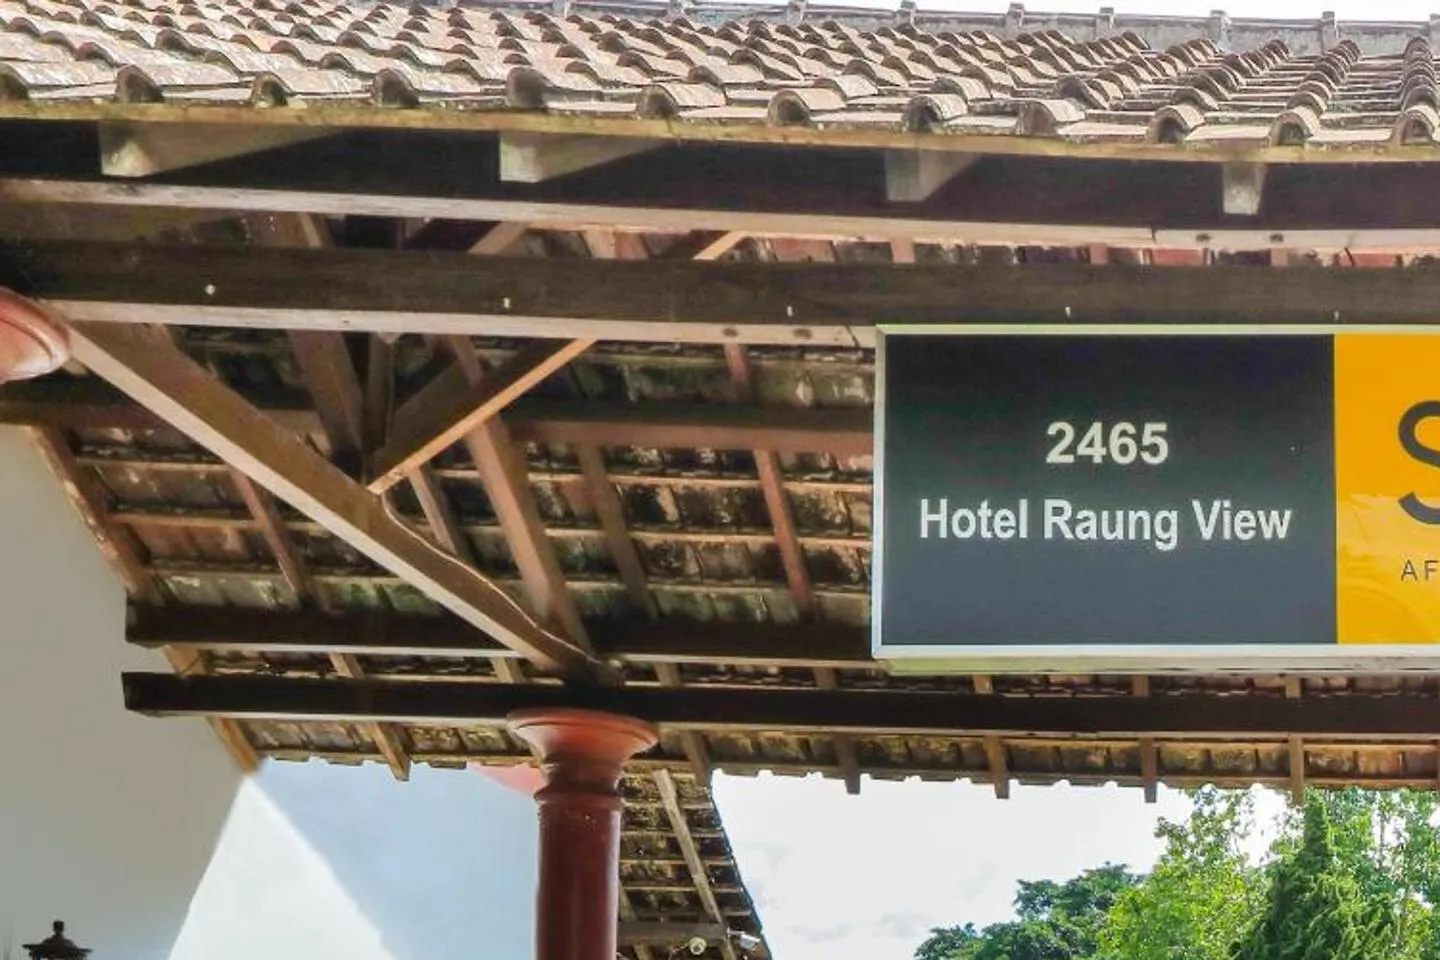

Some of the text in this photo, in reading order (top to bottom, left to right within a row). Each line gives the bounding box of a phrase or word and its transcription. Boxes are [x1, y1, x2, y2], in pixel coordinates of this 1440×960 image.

[1045, 420, 1170, 465] 2465
[919, 498, 1293, 552] Hotel Raung View
